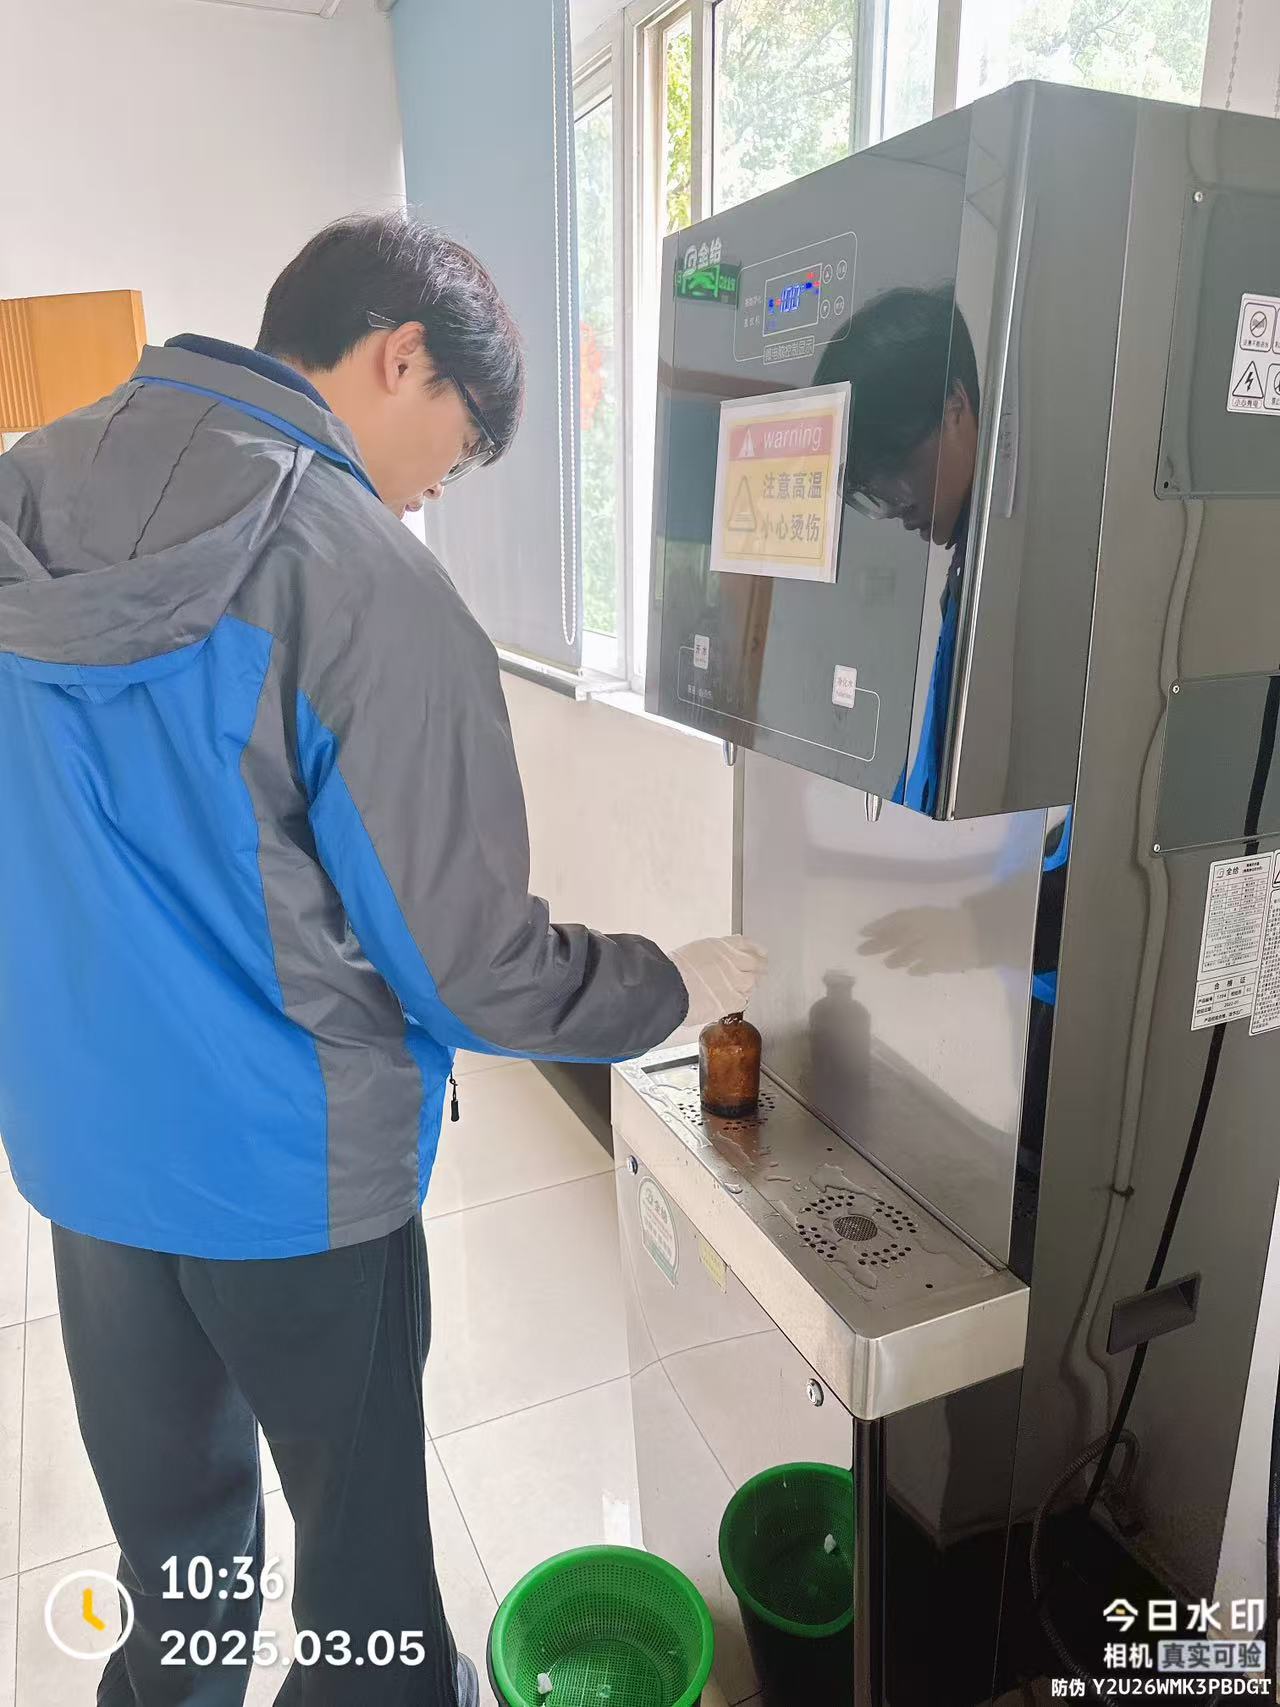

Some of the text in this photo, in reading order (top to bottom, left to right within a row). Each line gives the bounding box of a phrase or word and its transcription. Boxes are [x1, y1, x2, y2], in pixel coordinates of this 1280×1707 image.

[762, 423, 823, 451] warning
[763, 471, 823, 500] 注意高温
[761, 512, 821, 543] 小心烫伤
